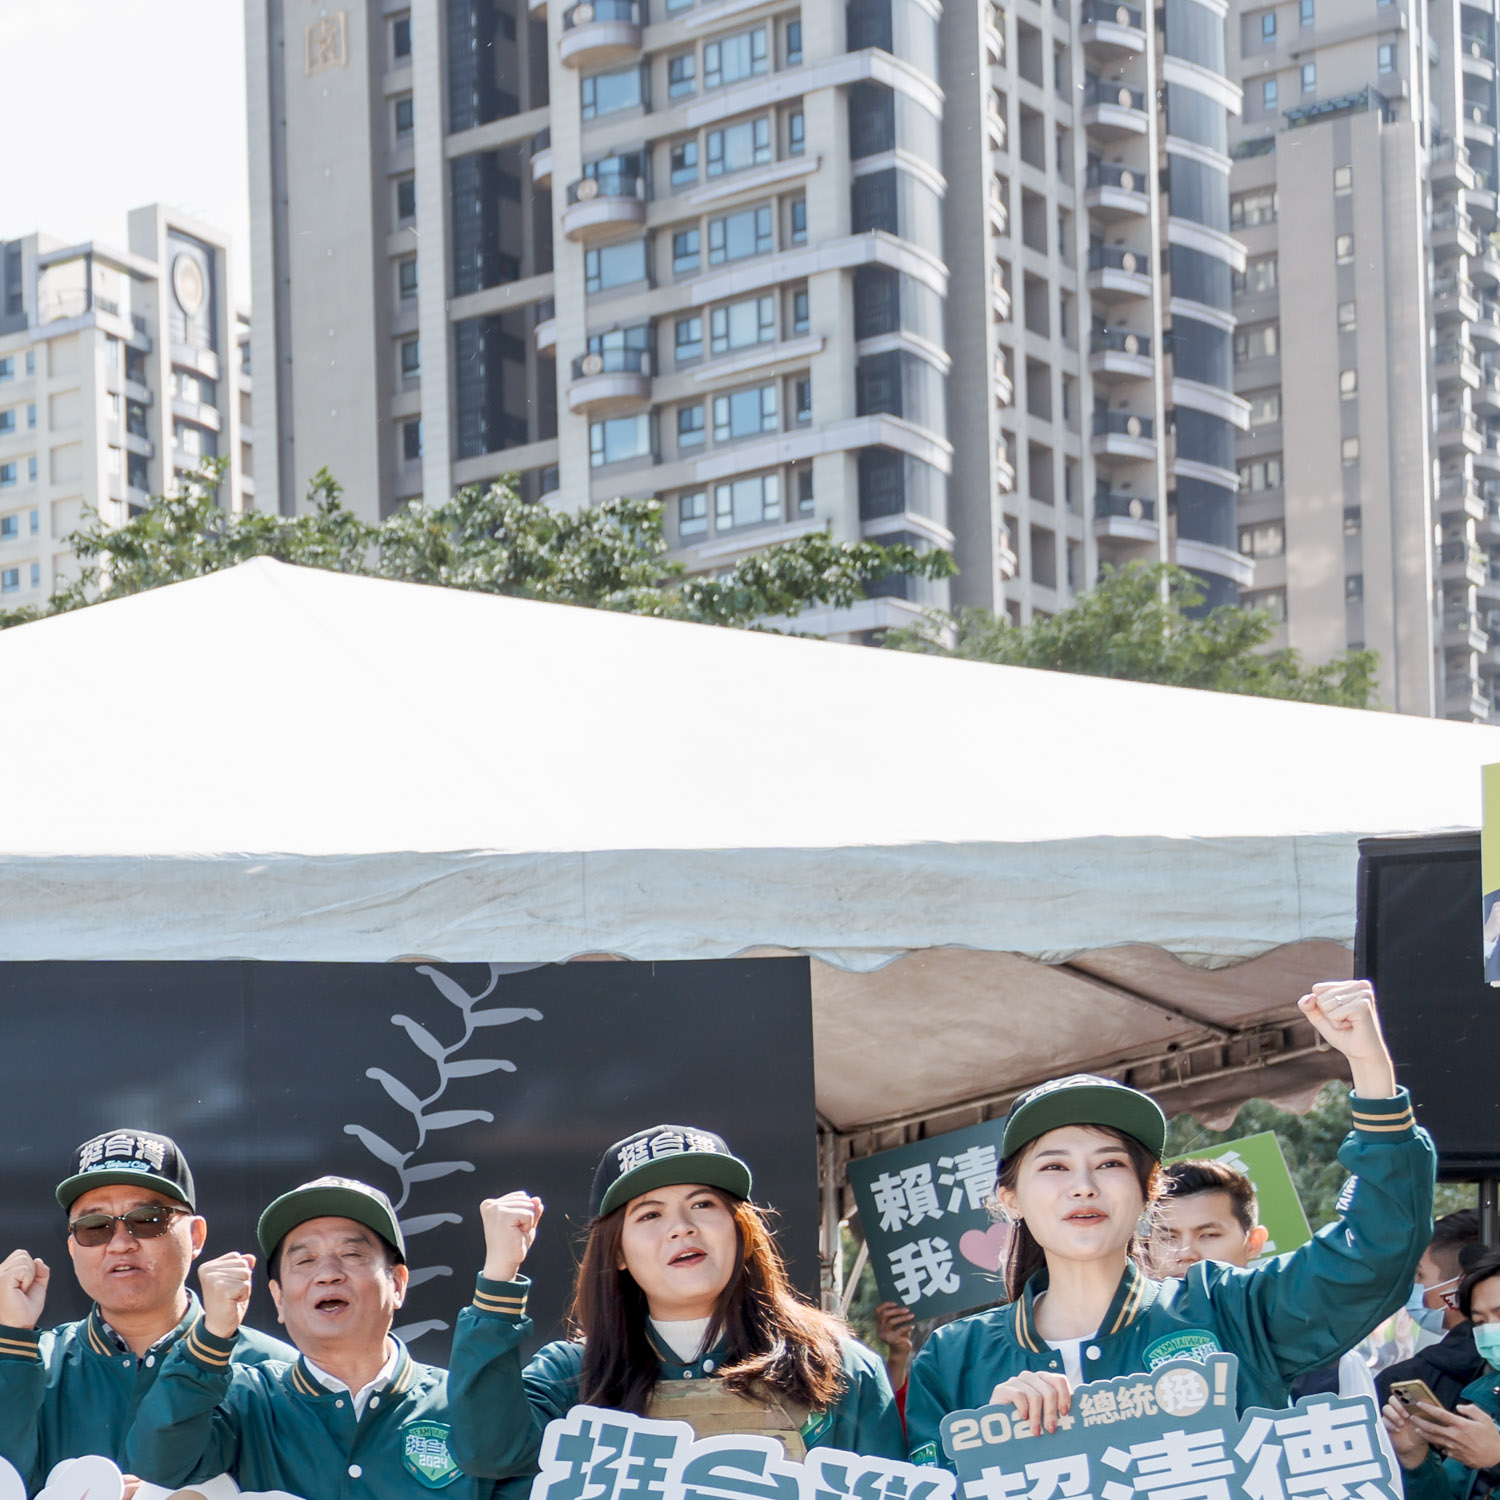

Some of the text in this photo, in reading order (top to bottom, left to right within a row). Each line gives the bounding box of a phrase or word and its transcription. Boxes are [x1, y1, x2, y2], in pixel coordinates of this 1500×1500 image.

[79, 1134, 166, 1174] 挺台灣
[887, 1236, 961, 1306] 我
[418, 1454, 449, 1470] 2024
